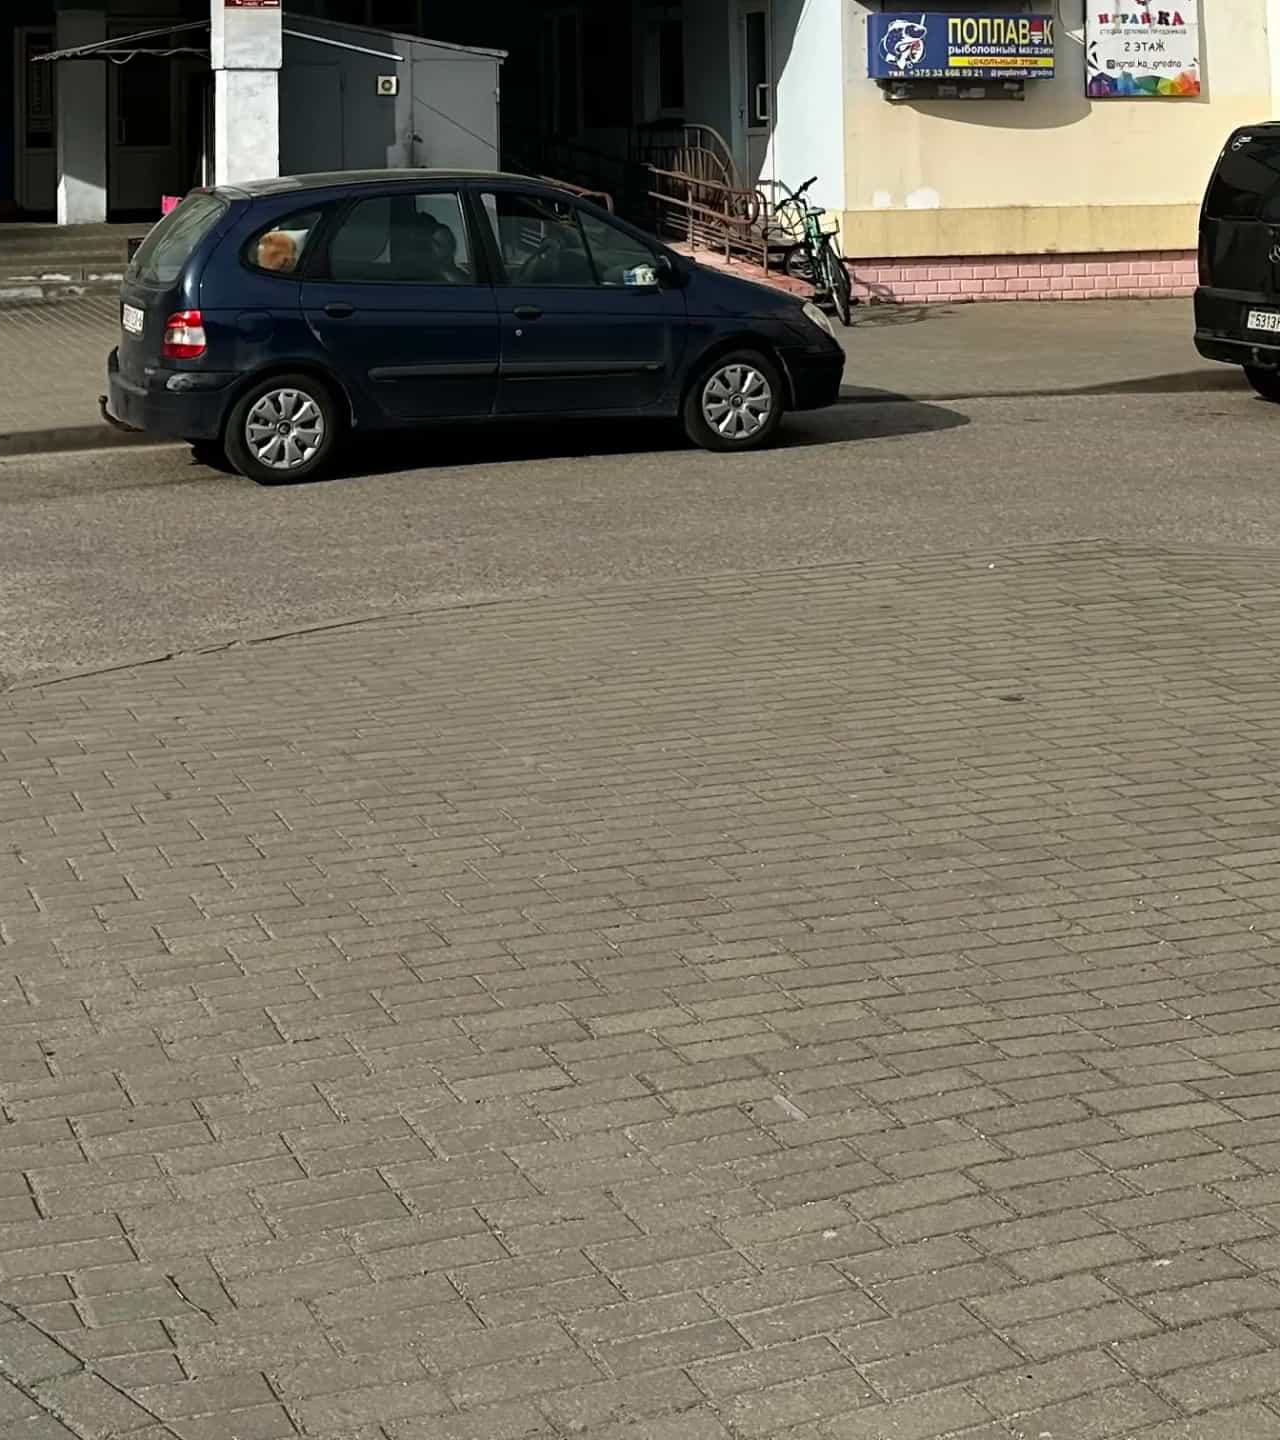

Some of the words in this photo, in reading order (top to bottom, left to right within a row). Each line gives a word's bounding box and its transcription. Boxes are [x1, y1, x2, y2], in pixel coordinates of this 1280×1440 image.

[947, 44, 1017, 56] рыболовный
[1123, 41, 1131, 52] 2
[1134, 39, 1165, 53] ЭТАЖ
